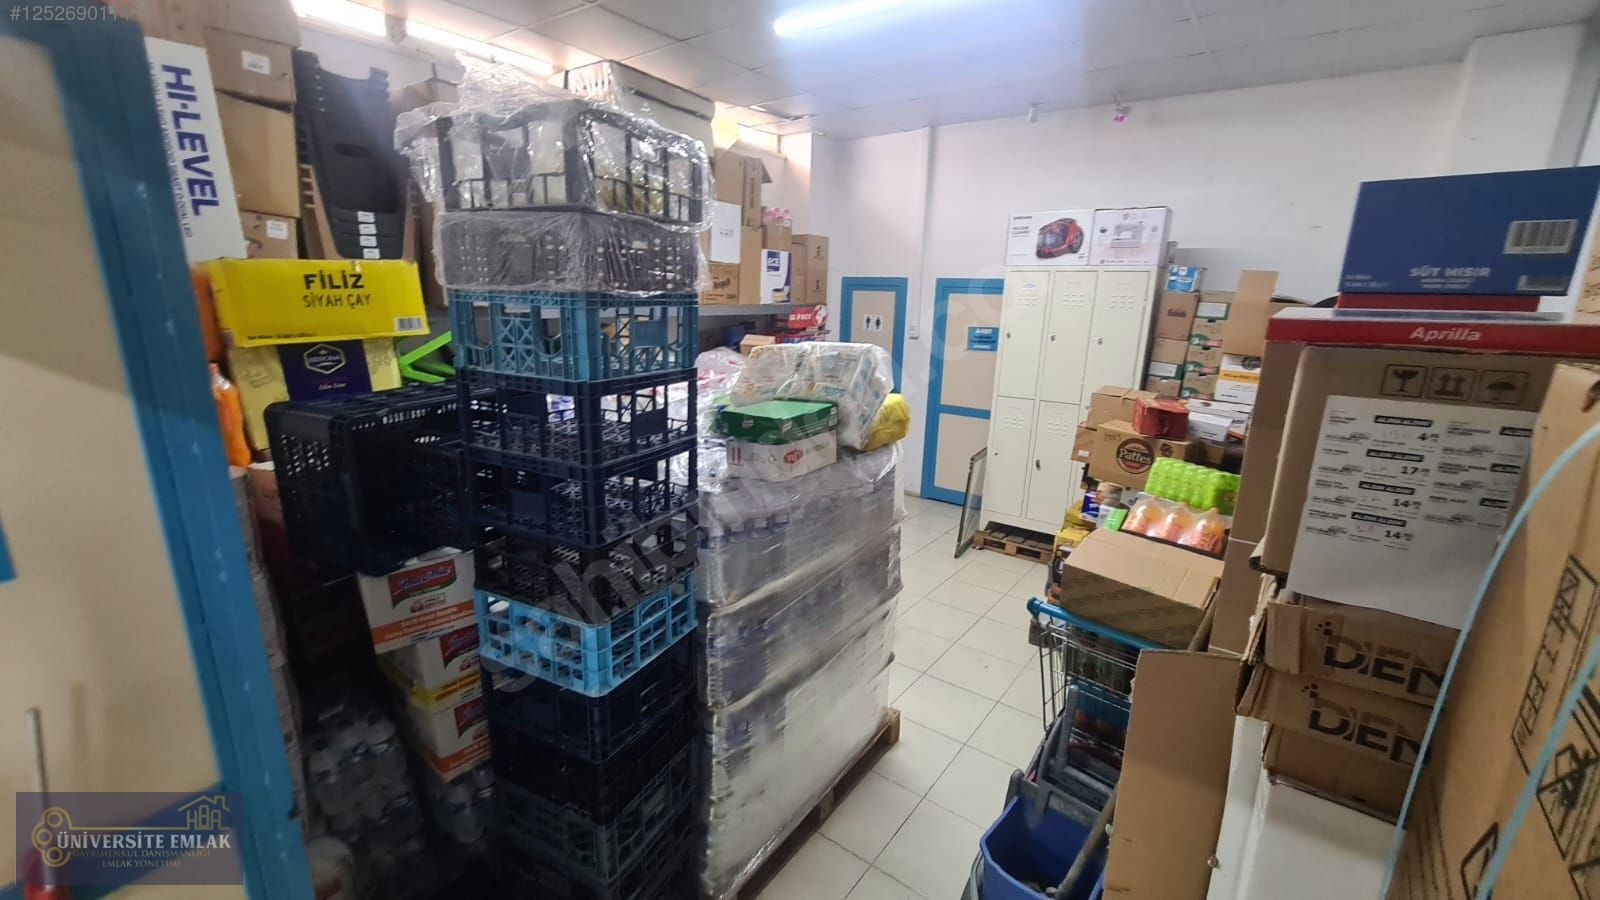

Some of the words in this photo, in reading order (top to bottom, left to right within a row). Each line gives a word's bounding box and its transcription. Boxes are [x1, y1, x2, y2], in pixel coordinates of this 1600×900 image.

[161, 64, 220, 217] HI-LEVEL
[1408, 264, 1441, 277] SÜT
[1444, 266, 1491, 277] MISIR
[303, 270, 365, 290] FİLİZ
[303, 293, 343, 309] SİYAH
[347, 294, 371, 310] ÇAY
